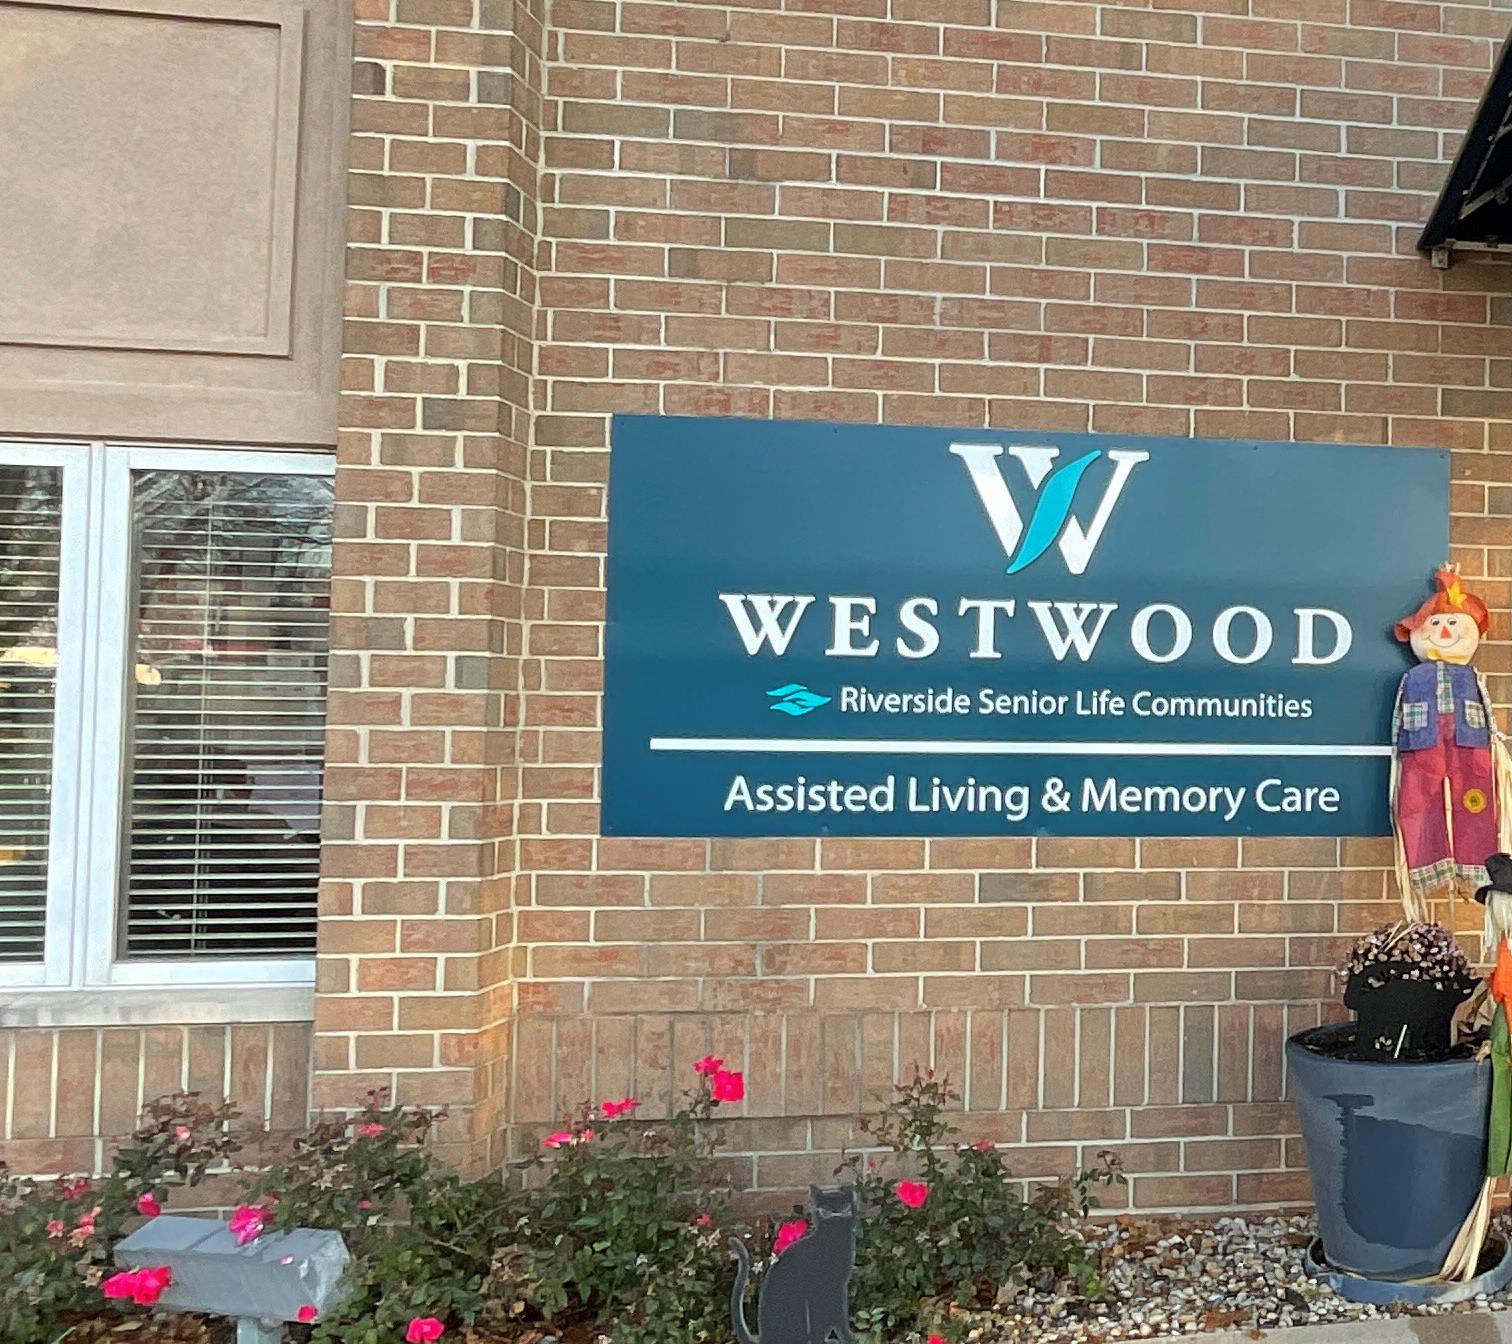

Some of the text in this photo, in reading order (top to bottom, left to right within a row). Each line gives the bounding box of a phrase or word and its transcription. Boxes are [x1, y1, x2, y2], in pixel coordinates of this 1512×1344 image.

[718, 593, 1353, 665] WESTWOOD
[840, 685, 1314, 720] Riverside Senior Life Communities
[723, 774, 1341, 823] Assisted Living & Memory Care
